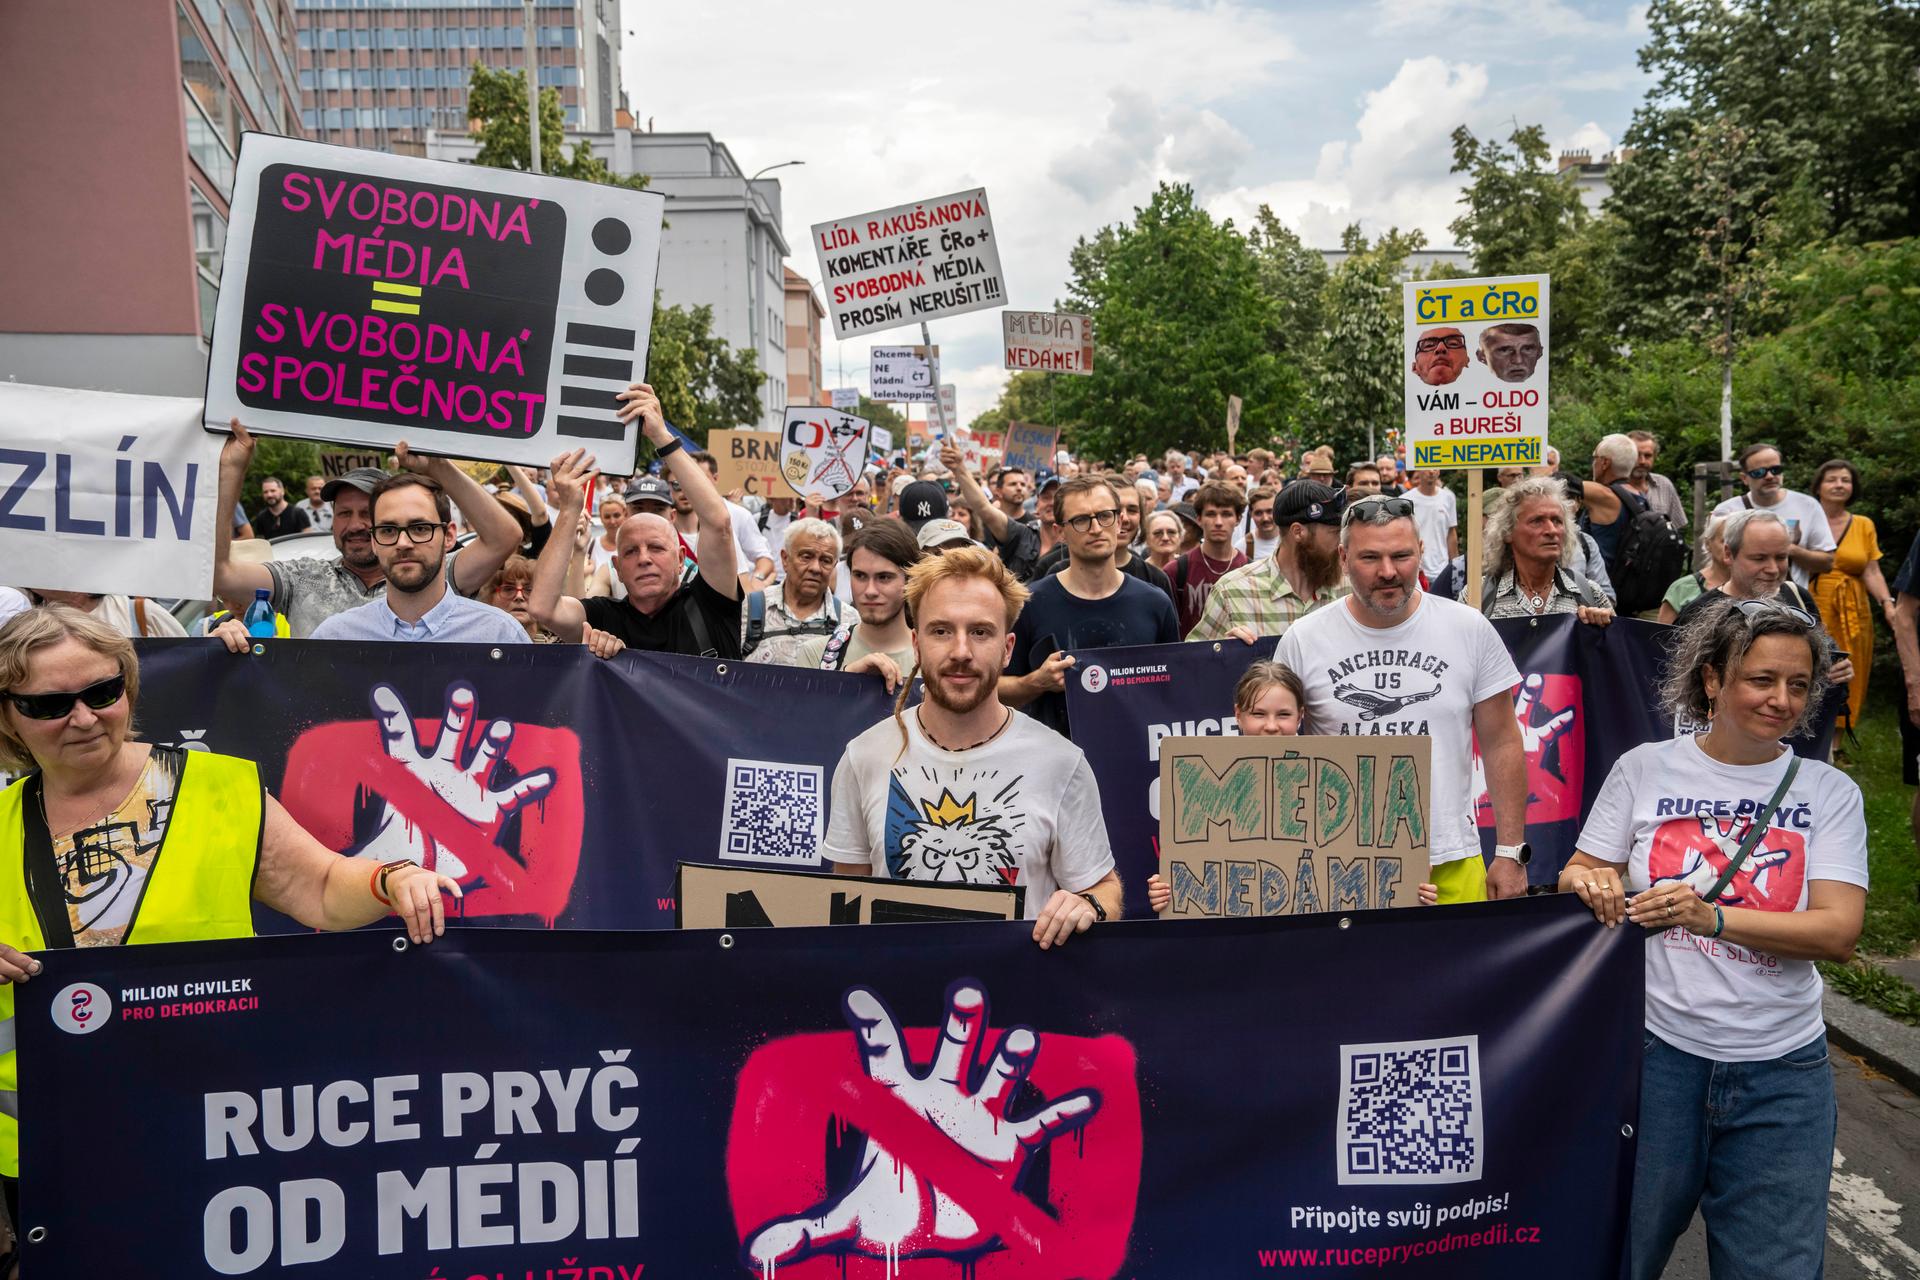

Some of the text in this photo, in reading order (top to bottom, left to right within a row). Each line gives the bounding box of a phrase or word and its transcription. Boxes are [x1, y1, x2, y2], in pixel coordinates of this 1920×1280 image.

[281, 173, 539, 244] SVOBODNÁ
[820, 192, 985, 251] LÍDA RAKUŠANOVÁ
[313, 225, 470, 290] MÉDIA
[827, 235, 931, 278] KOMENTÁŘE
[833, 254, 985, 304] SVOBODNÁ MÉDIA
[839, 276, 1000, 331] PROSÍM NERUŠIT!!!
[1417, 285, 1537, 320] ČT a ČRo
[256, 303, 531, 376] SVOBODNÁ
[1010, 312, 1074, 339] MÉDIA
[873, 350, 912, 358] Chceme
[875, 364, 889, 373] NE
[1008, 347, 1080, 371] NEDÁME!
[237, 352, 545, 433] SPOLEČNOST
[873, 391, 937, 400] teleshopping
[1417, 390, 1460, 411] VÁM
[1482, 389, 1539, 408] OLDO
[1433, 411, 1521, 436] a BUREŠI
[731, 437, 779, 462] BRN
[0, 435, 198, 541] ZLÍN
[640, 482, 657, 491] CAT
[1110, 664, 1168, 677] MILION CHVILEK
[1327, 649, 1449, 684] ANCHORAGE
[1374, 672, 1401, 689] US
[1340, 720, 1430, 736] ALASKA
[1172, 751, 1427, 849] MÉDIA
[1656, 797, 1731, 817] RUCE
[1171, 849, 1402, 917] NEDÁME
[121, 978, 252, 1002] MILION CHVILEK
[122, 996, 259, 1021] PRO DEMOKRACII
[204, 1048, 640, 1160] RUCE PRYČ
[203, 1137, 642, 1275] OD MÉDIÍ
[1290, 1192, 1509, 1233] Připojte svůj podpis!
[1258, 1223, 1541, 1268] www.ruceprycodmedii.cz
